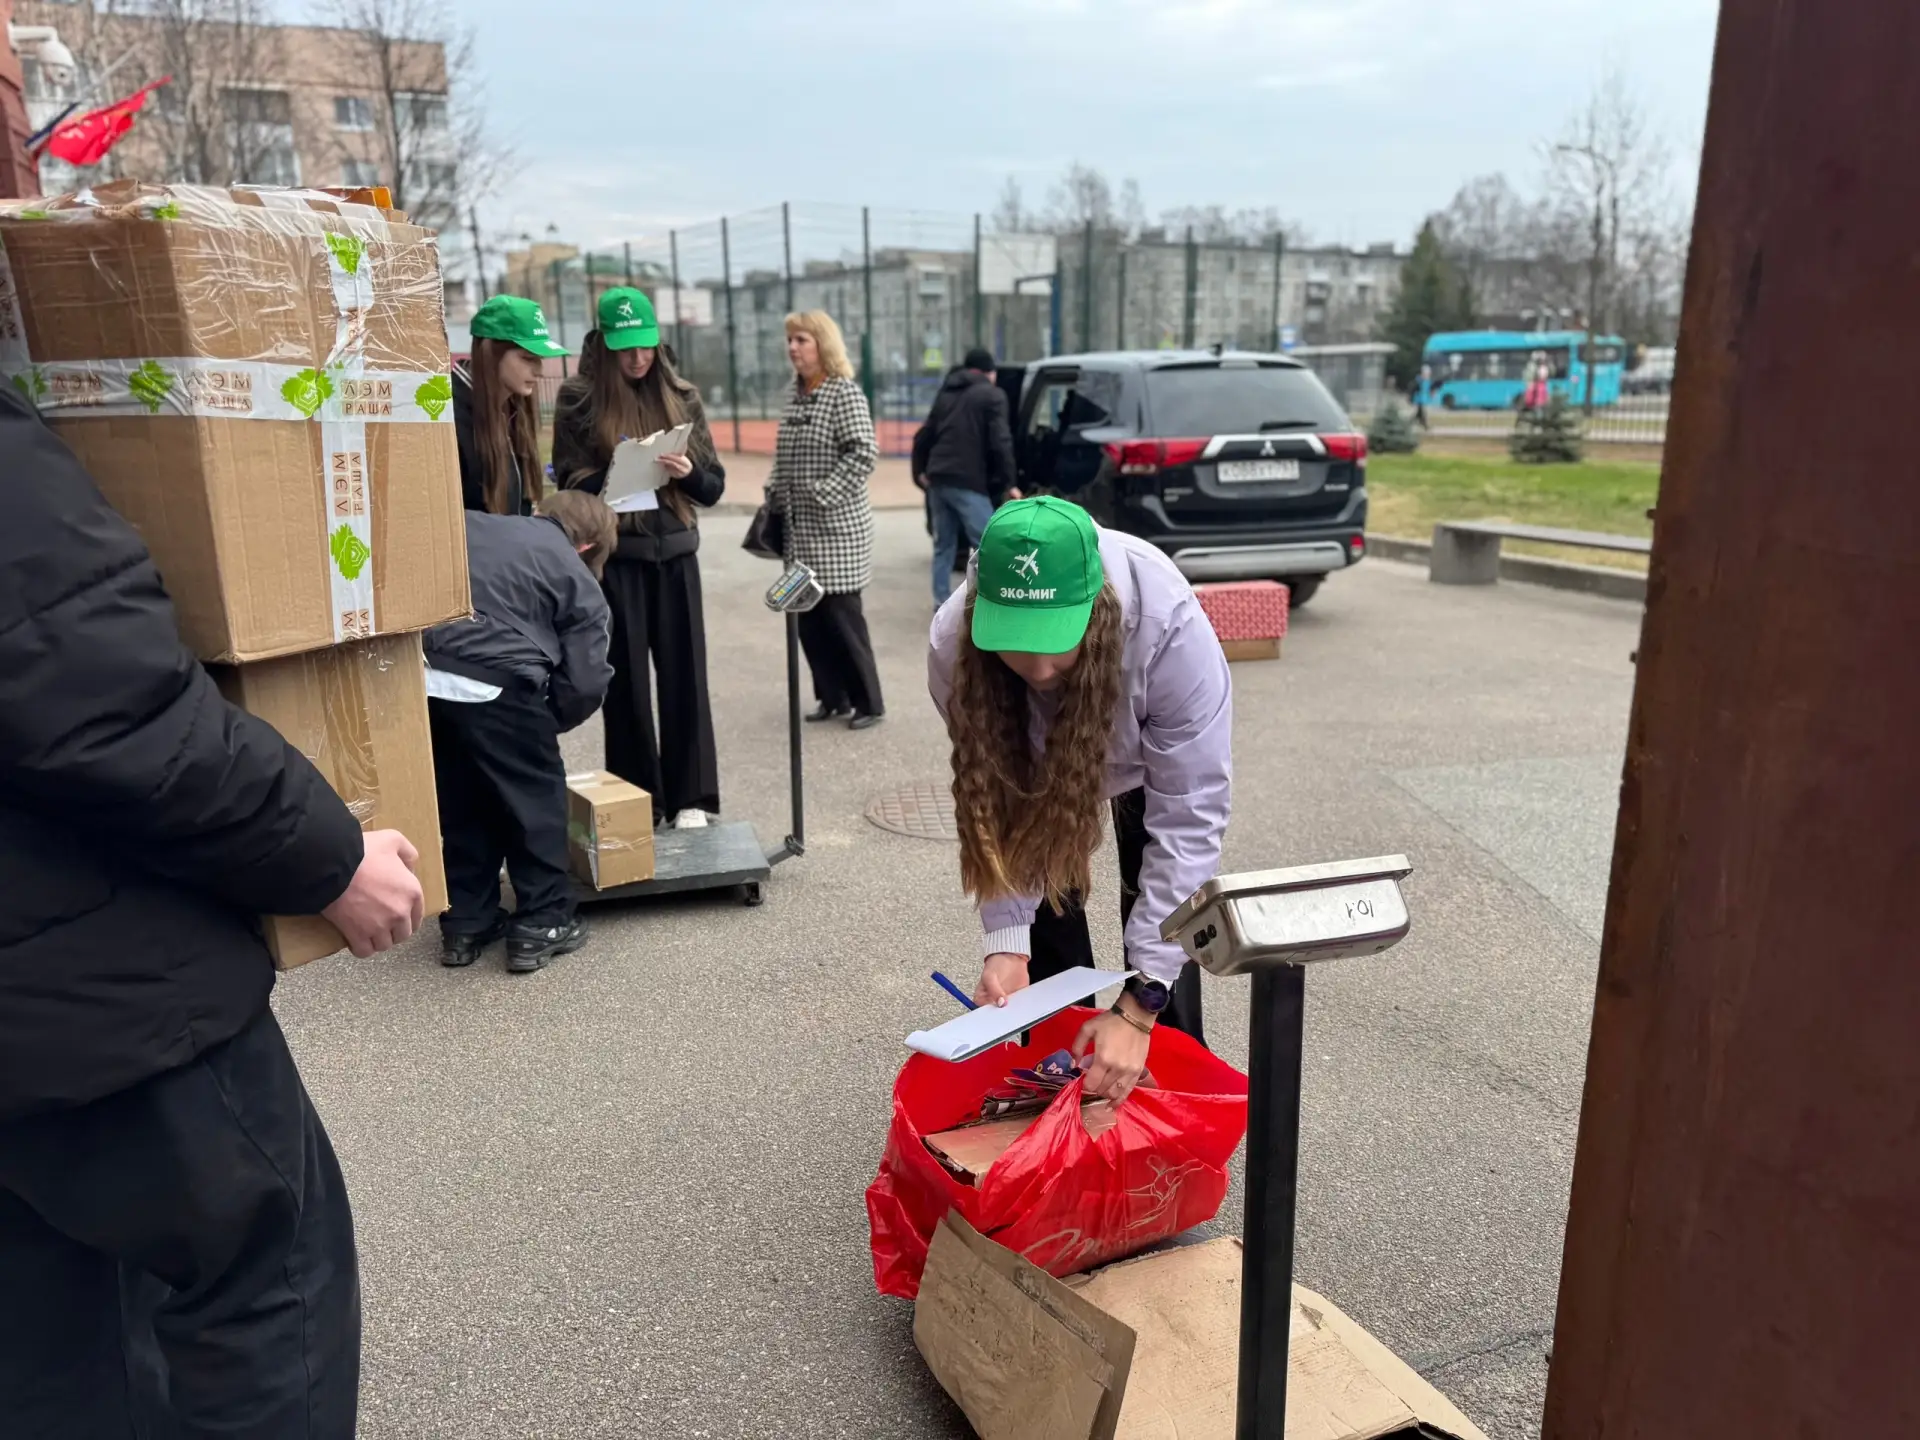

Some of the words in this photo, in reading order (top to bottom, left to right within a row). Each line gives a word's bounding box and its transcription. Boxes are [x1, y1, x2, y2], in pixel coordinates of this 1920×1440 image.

[344, 381, 391, 396] ЛЭМ
[345, 403, 390, 415] РАША
[334, 454, 348, 512] ЛЭМ
[352, 455, 363, 511] РАША
[1000, 587, 1057, 600] ЭКО-МИГ
